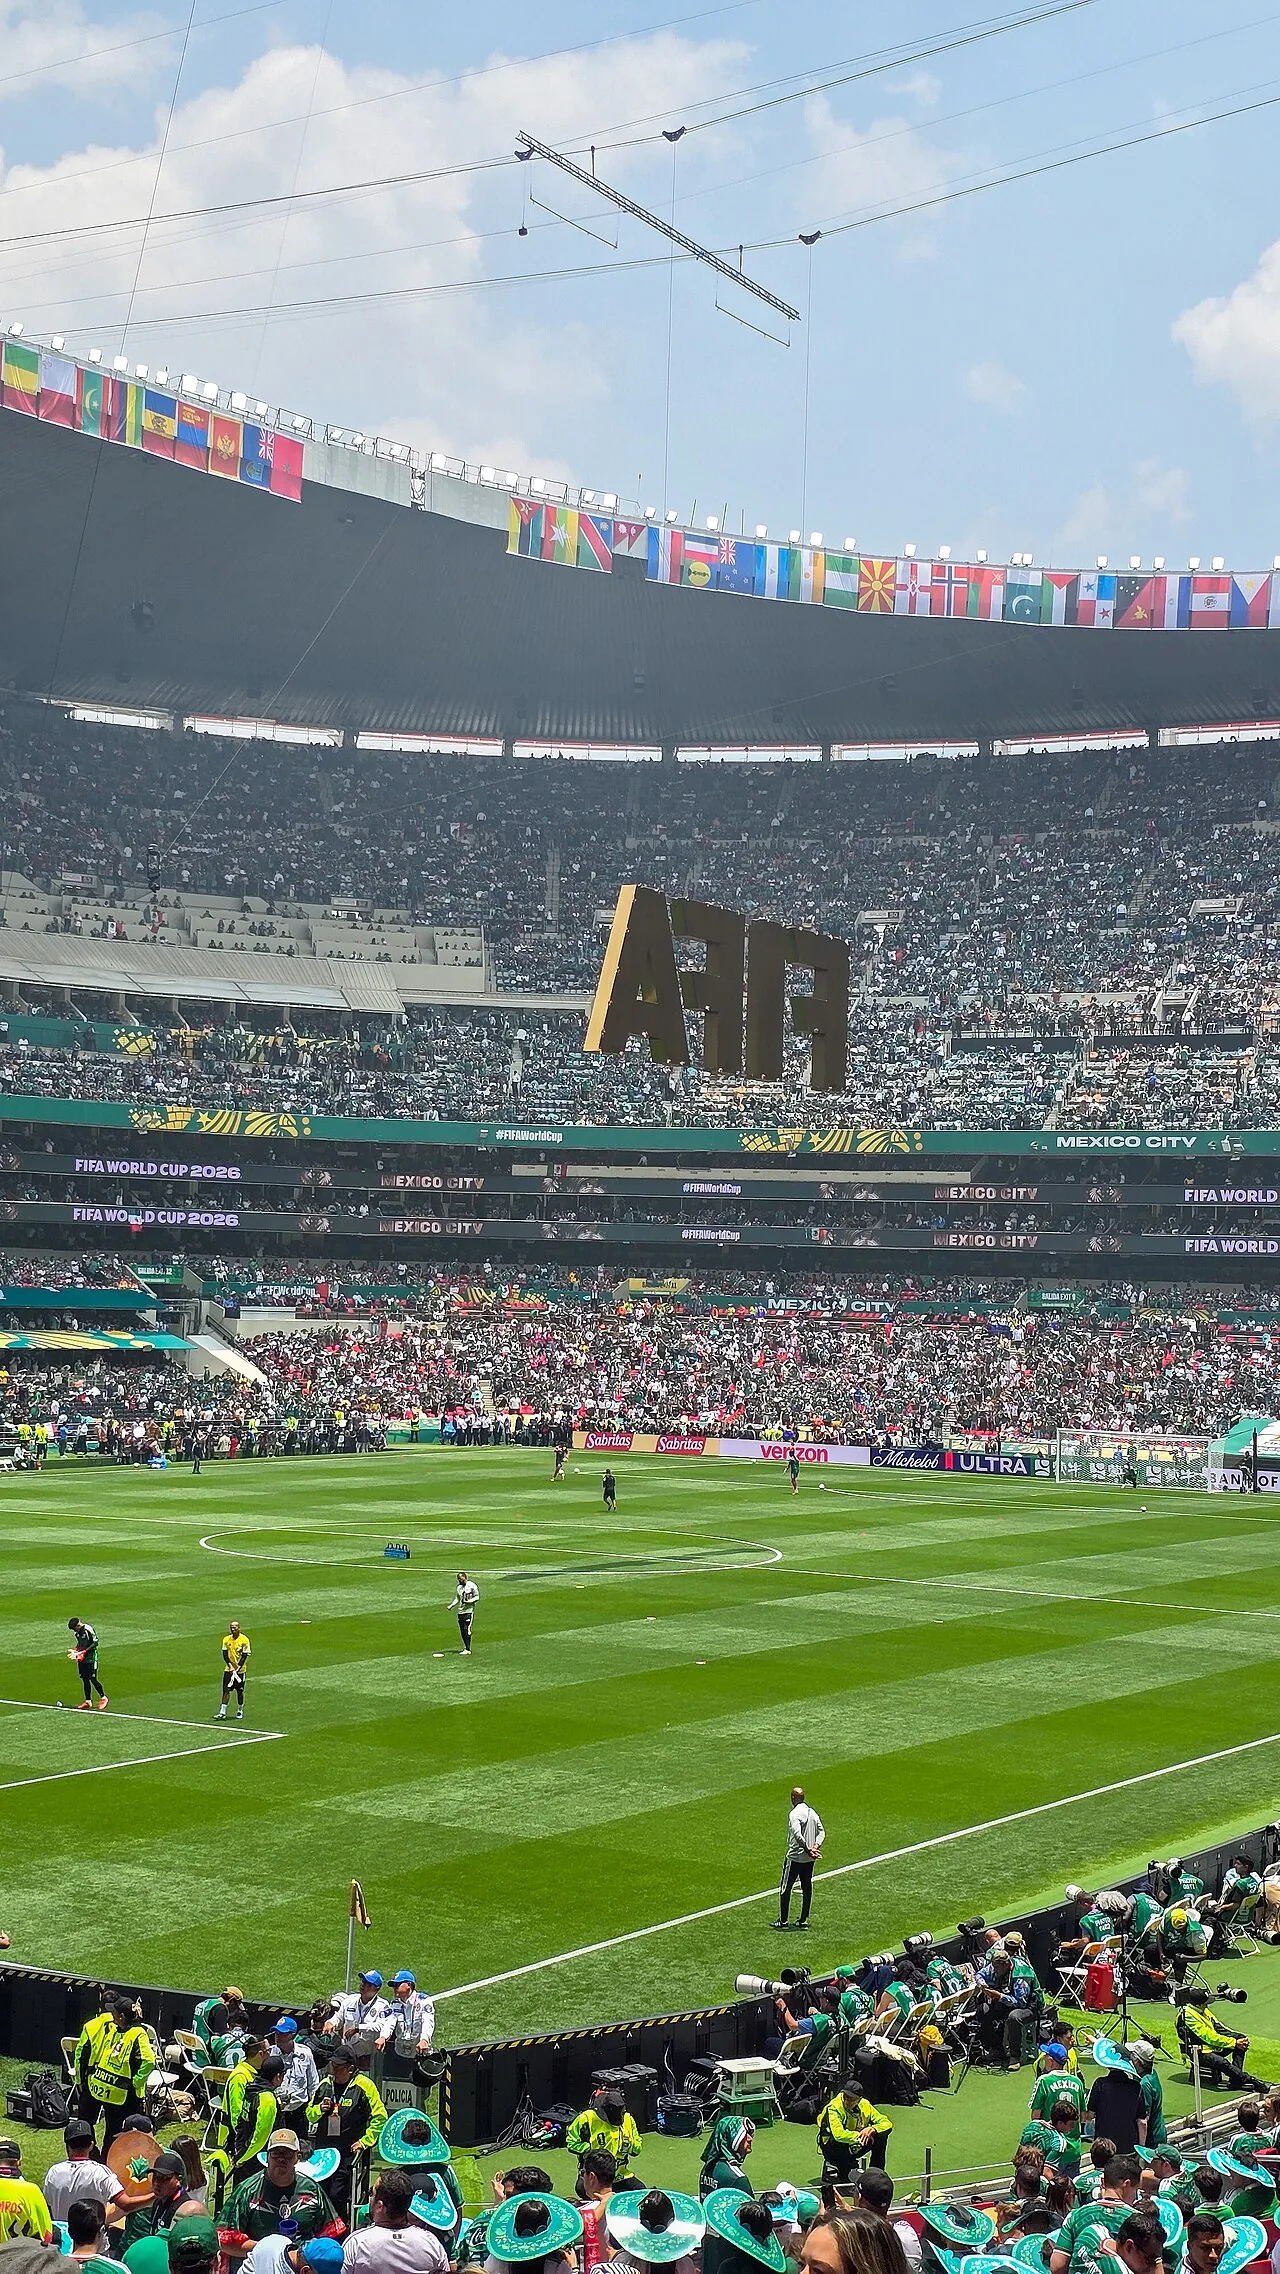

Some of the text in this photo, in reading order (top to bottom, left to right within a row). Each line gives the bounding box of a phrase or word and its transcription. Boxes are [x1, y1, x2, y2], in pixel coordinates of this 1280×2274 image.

[495, 1129, 563, 1143] #FIFAWorldCup
[1056, 1135, 1197, 1148] MEXICO CITY
[75, 1158, 241, 1180] FIFA WORLD CUP 2026
[381, 1174, 485, 1190] MEXICO CITY
[682, 1182, 741, 1195] #FIFAWorldCup
[934, 1186, 1038, 1200] MEXICO CITY
[1183, 1189, 1279, 1203] FIFA WORLD
[73, 1208, 239, 1227] FIFA WOLD CUP 2026
[379, 1220, 484, 1235] MEXICO CITY
[681, 1229, 740, 1241] #FIFAWorldCup
[933, 1234, 1038, 1248] MEXICO CITY
[1185, 1239, 1279, 1254] FIFA WORLD
[1041, 1292, 1060, 1300] SALIDA
[586, 1432, 632, 1449] Sabritas
[657, 1435, 704, 1453] Sabritas
[760, 1444, 829, 1463] verzon
[872, 1449, 1028, 1474] Michelob ULTRA
[1258, 1475, 1279, 1487] OF
[1050, 2079, 1080, 2093] MEXICO
[386, 2088, 413, 2107] POLICIA
